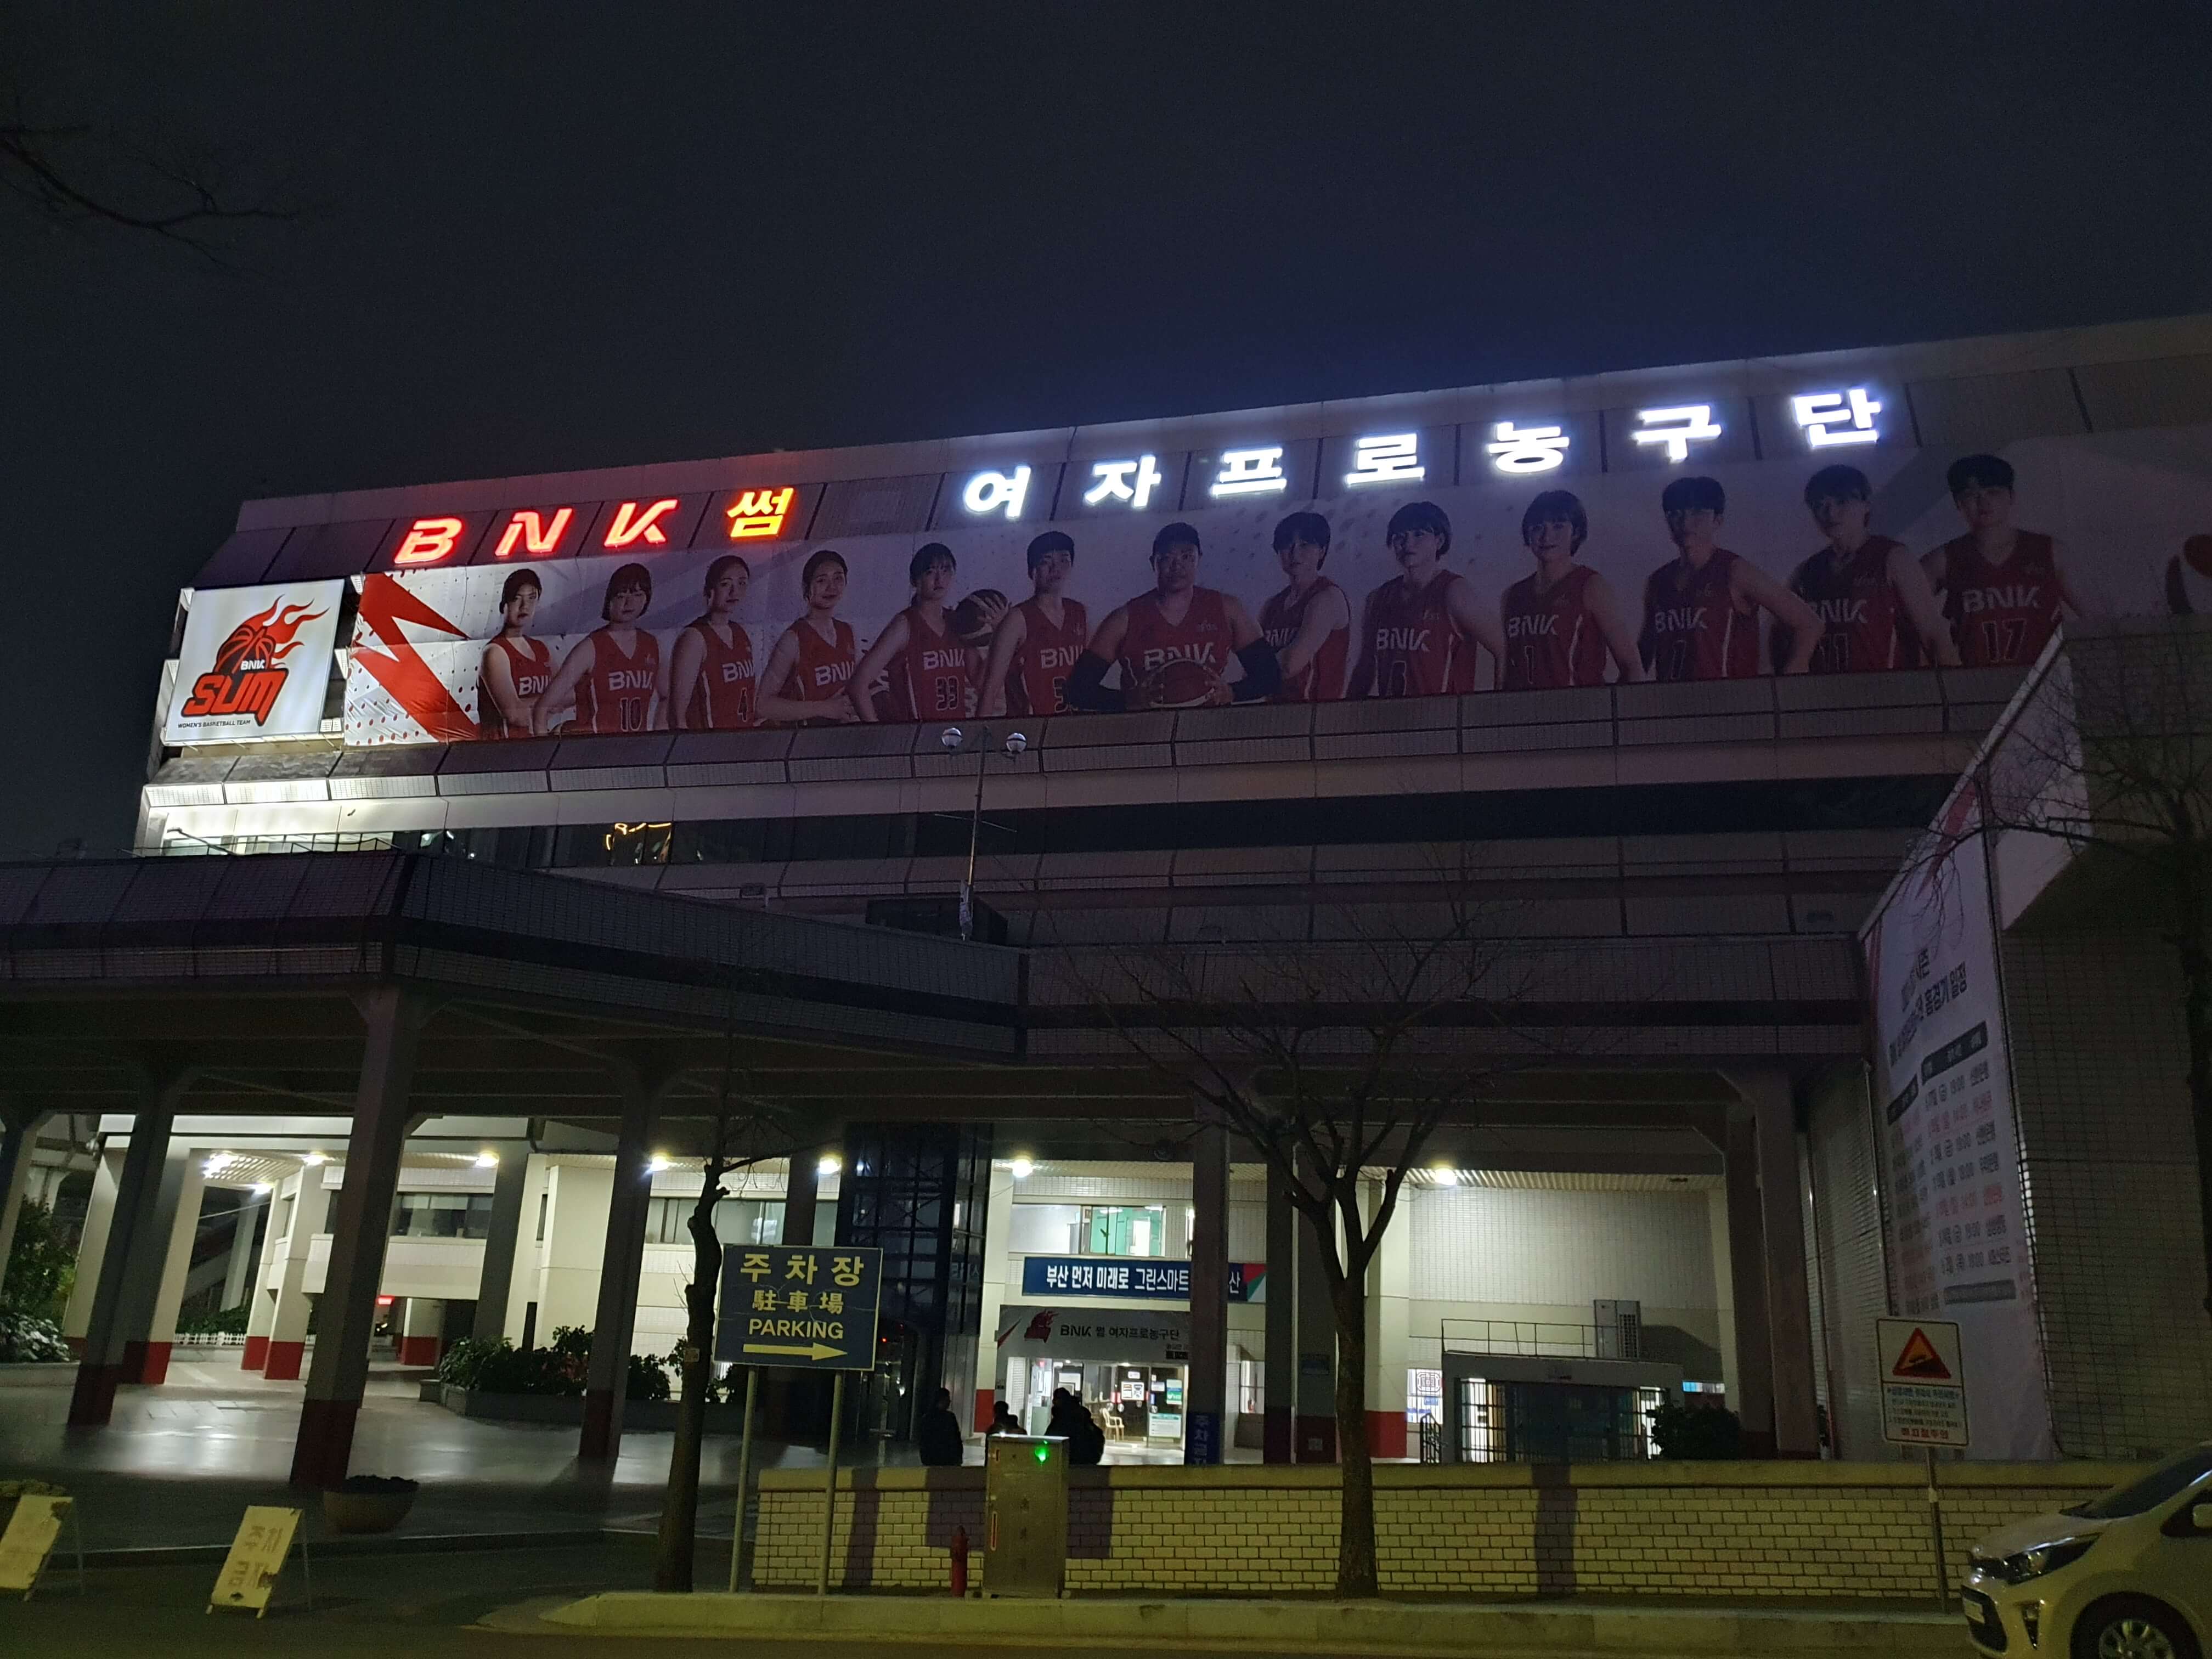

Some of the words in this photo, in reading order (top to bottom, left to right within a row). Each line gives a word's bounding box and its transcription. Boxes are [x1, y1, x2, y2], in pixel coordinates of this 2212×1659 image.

[394, 499, 679, 565] BNK
[727, 487, 794, 539] 썸
[963, 388, 1882, 518] 여자프로농구단
[1508, 614, 1560, 637] BNK
[1377, 627, 1431, 652] BNK
[240, 659, 265, 670] BNK
[620, 697, 642, 732] 10
[740, 1253, 865, 1286] 주차장
[1046, 1265, 1069, 1289] 부산
[1072, 1266, 1093, 1290] 먼저
[1097, 1266, 1129, 1290] 미래로
[1134, 1268, 1189, 1293] 그린스마트
[748, 1318, 844, 1340] PARKING
[1059, 1324, 1092, 1337] BNK
